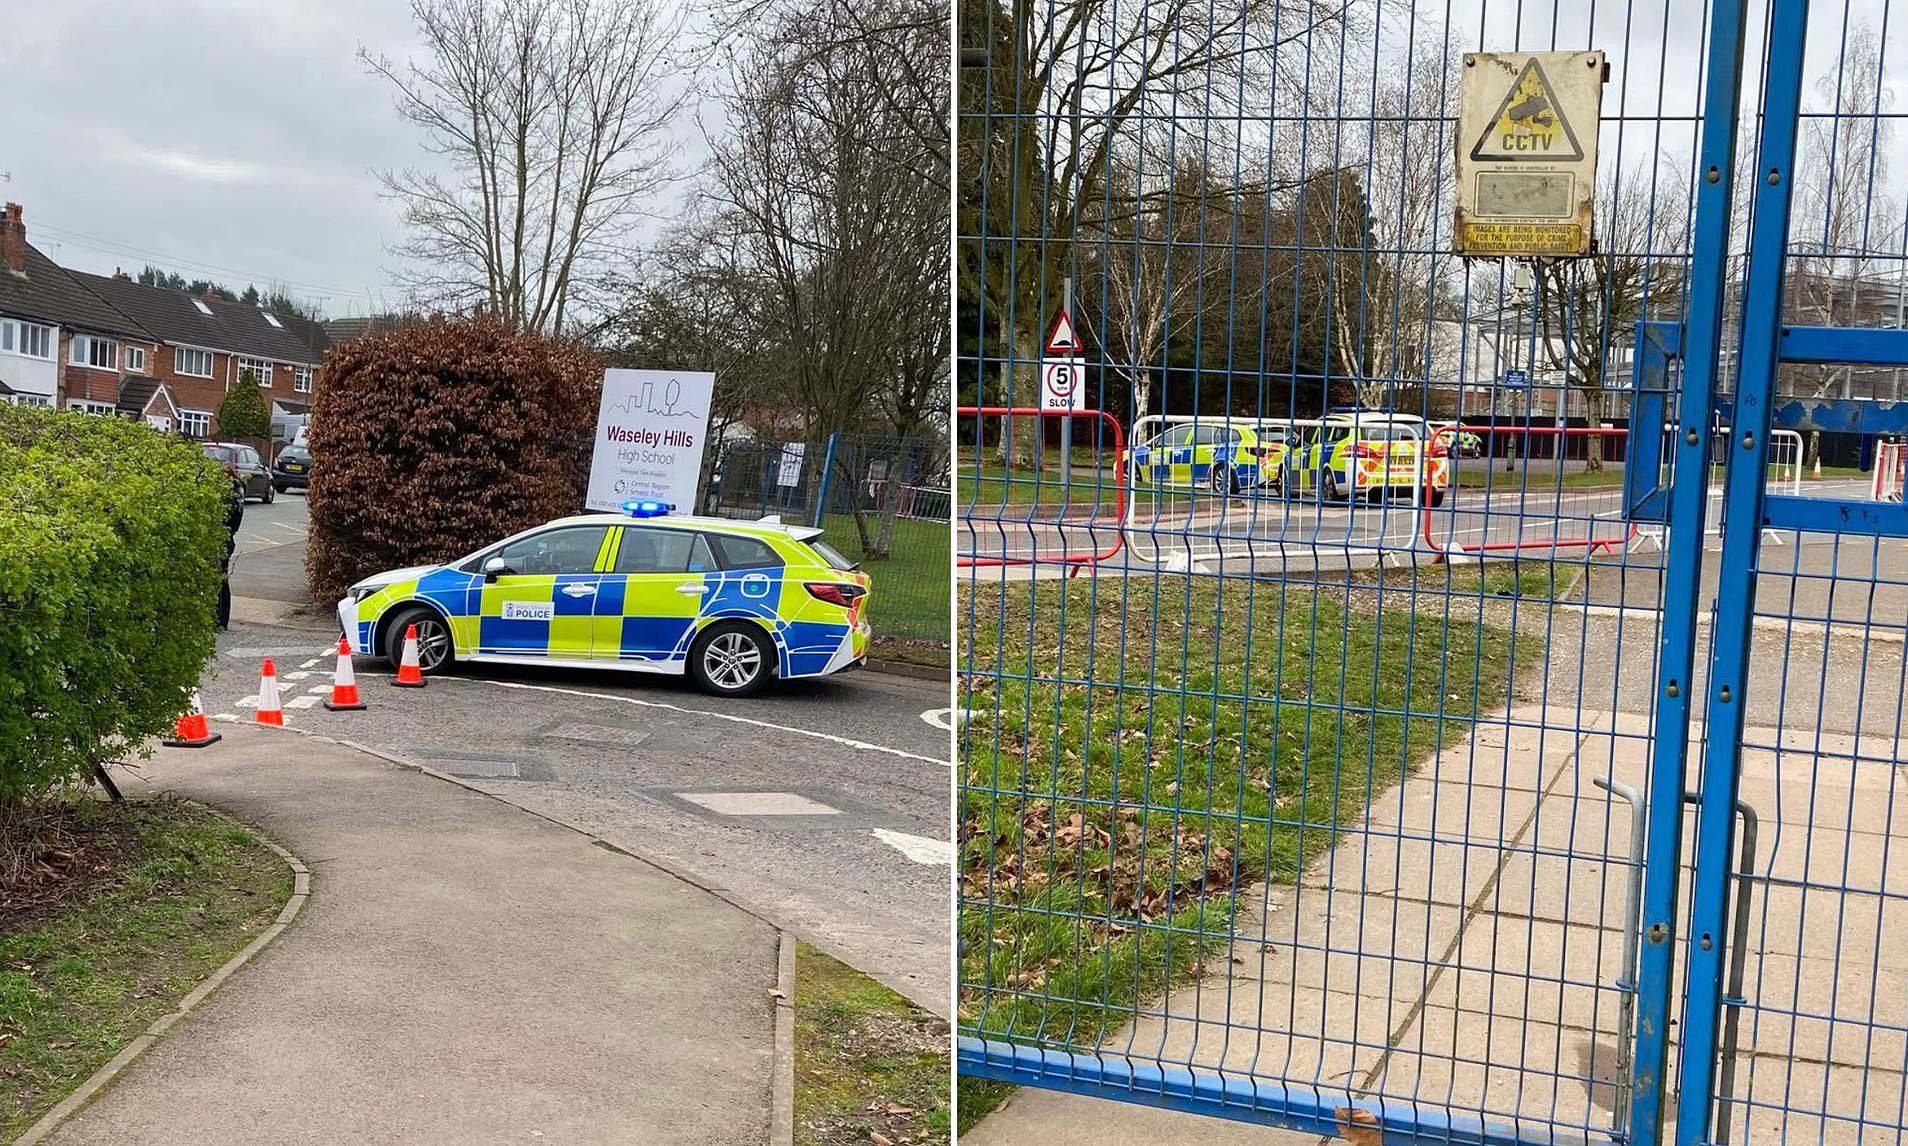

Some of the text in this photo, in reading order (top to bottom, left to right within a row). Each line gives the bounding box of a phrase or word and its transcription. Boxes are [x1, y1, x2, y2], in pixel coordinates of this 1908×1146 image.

[1502, 134, 1553, 151] CCTV
[1473, 225, 1570, 234] IMAGES ARE BEING MONITORED
[1476, 233, 1567, 242] FOR THE PURPOSE OF CRIME
[1469, 242, 1507, 250] PREVENTION
[1509, 242, 1521, 250] AND
[1056, 367, 1068, 385] 5
[1049, 398, 1075, 407] SLOW
[608, 425, 694, 448] Waseley Hills
[618, 448, 674, 464] High School
[516, 609, 550, 618] POLICE
